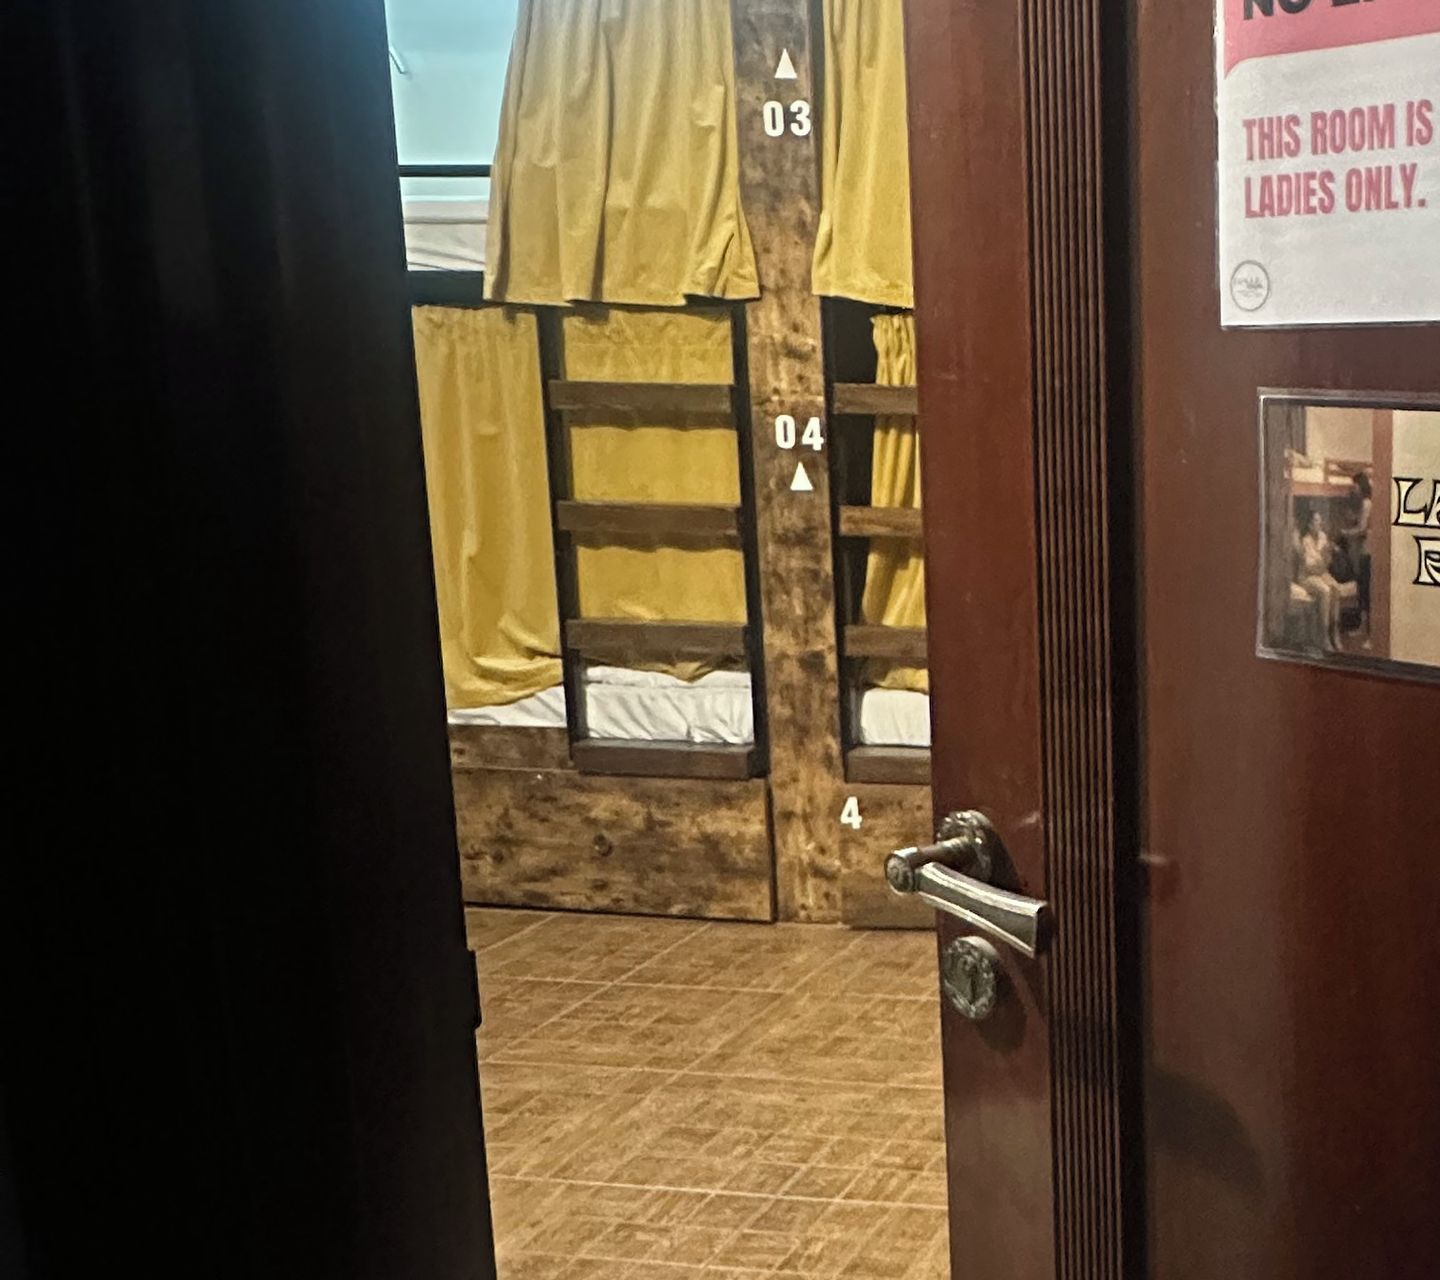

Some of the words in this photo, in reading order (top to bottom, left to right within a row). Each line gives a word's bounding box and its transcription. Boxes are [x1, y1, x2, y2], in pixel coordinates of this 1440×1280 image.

[763, 100, 811, 136] 03
[1242, 114, 1301, 161] THIS
[1311, 103, 1396, 155] ROOM
[1406, 99, 1433, 147] IS
[1244, 170, 1336, 219] LADIES
[1345, 162, 1426, 212] ONLY.
[775, 414, 824, 451] 04
[840, 796, 862, 829] 4
